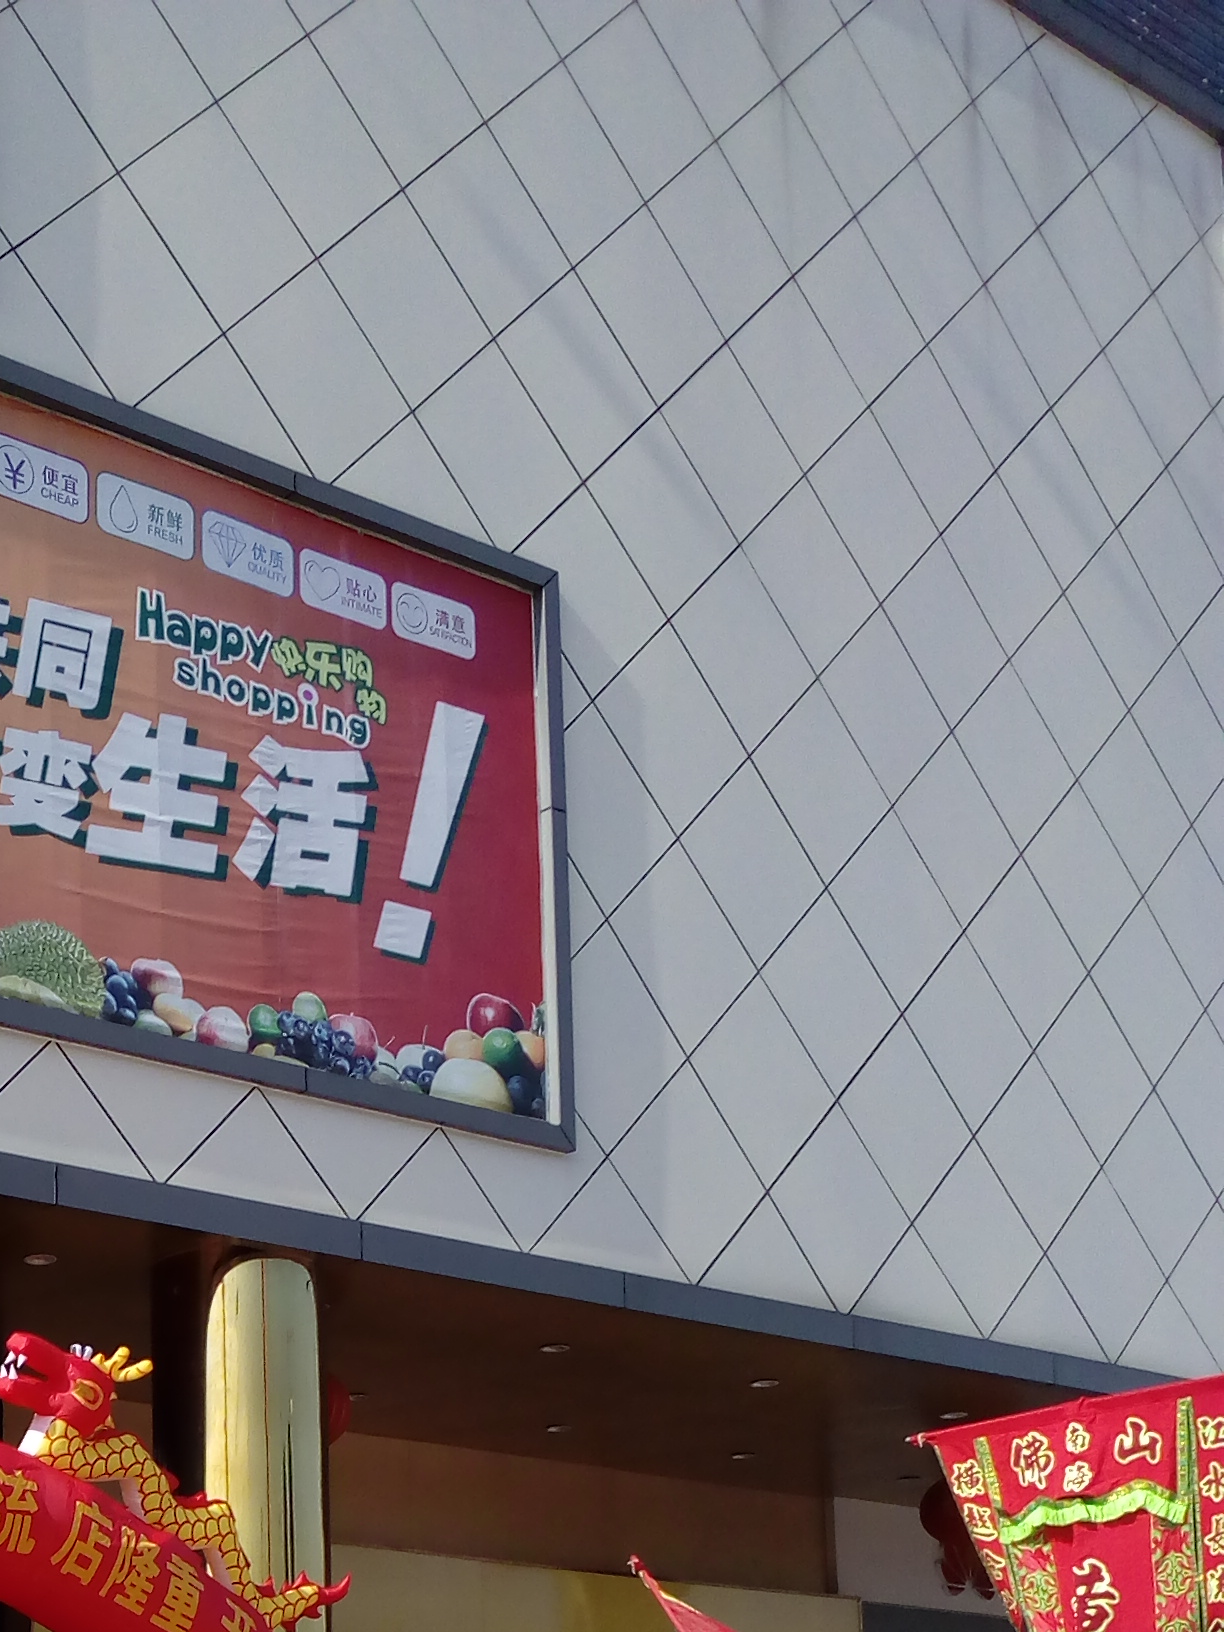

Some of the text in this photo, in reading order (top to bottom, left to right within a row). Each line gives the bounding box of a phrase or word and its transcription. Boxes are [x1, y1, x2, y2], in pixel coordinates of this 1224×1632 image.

[42, 465, 79, 496] 便宜
[41, 487, 80, 508] CHEAP
[147, 503, 183, 532] 新鲜
[147, 525, 184, 546] FRESH
[251, 541, 285, 572] 优质
[247, 561, 287, 585] QUALITY
[345, 577, 378, 603] 贴心
[340, 598, 384, 619] INTIMATE
[435, 608, 466, 635] 满意
[136, 586, 273, 673] Happy
[173, 655, 370, 749] shopping
